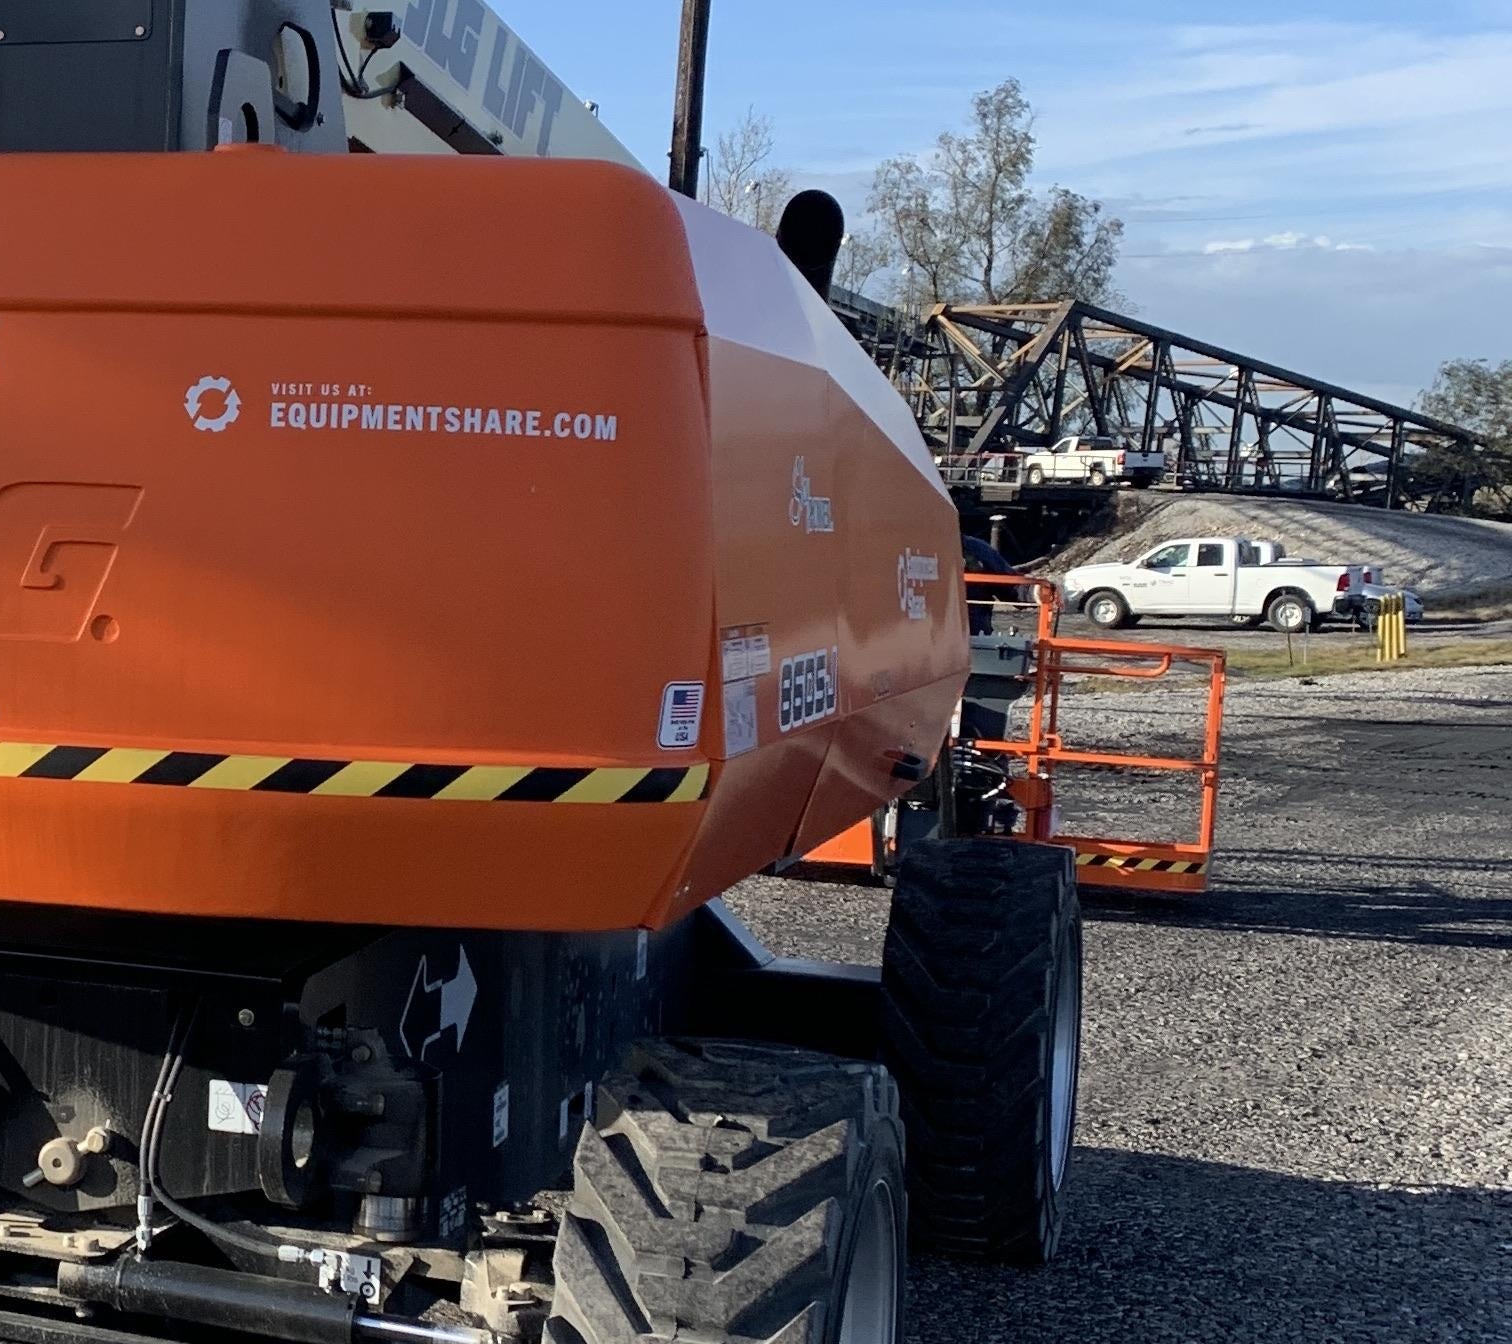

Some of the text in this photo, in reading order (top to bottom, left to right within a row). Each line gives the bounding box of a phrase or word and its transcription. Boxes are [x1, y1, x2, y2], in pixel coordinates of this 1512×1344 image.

[482, 24, 564, 155] LIFT
[271, 383, 373, 397] VISIT US AT:
[270, 402, 618, 441] EQUIPMENTSHARE.COM
